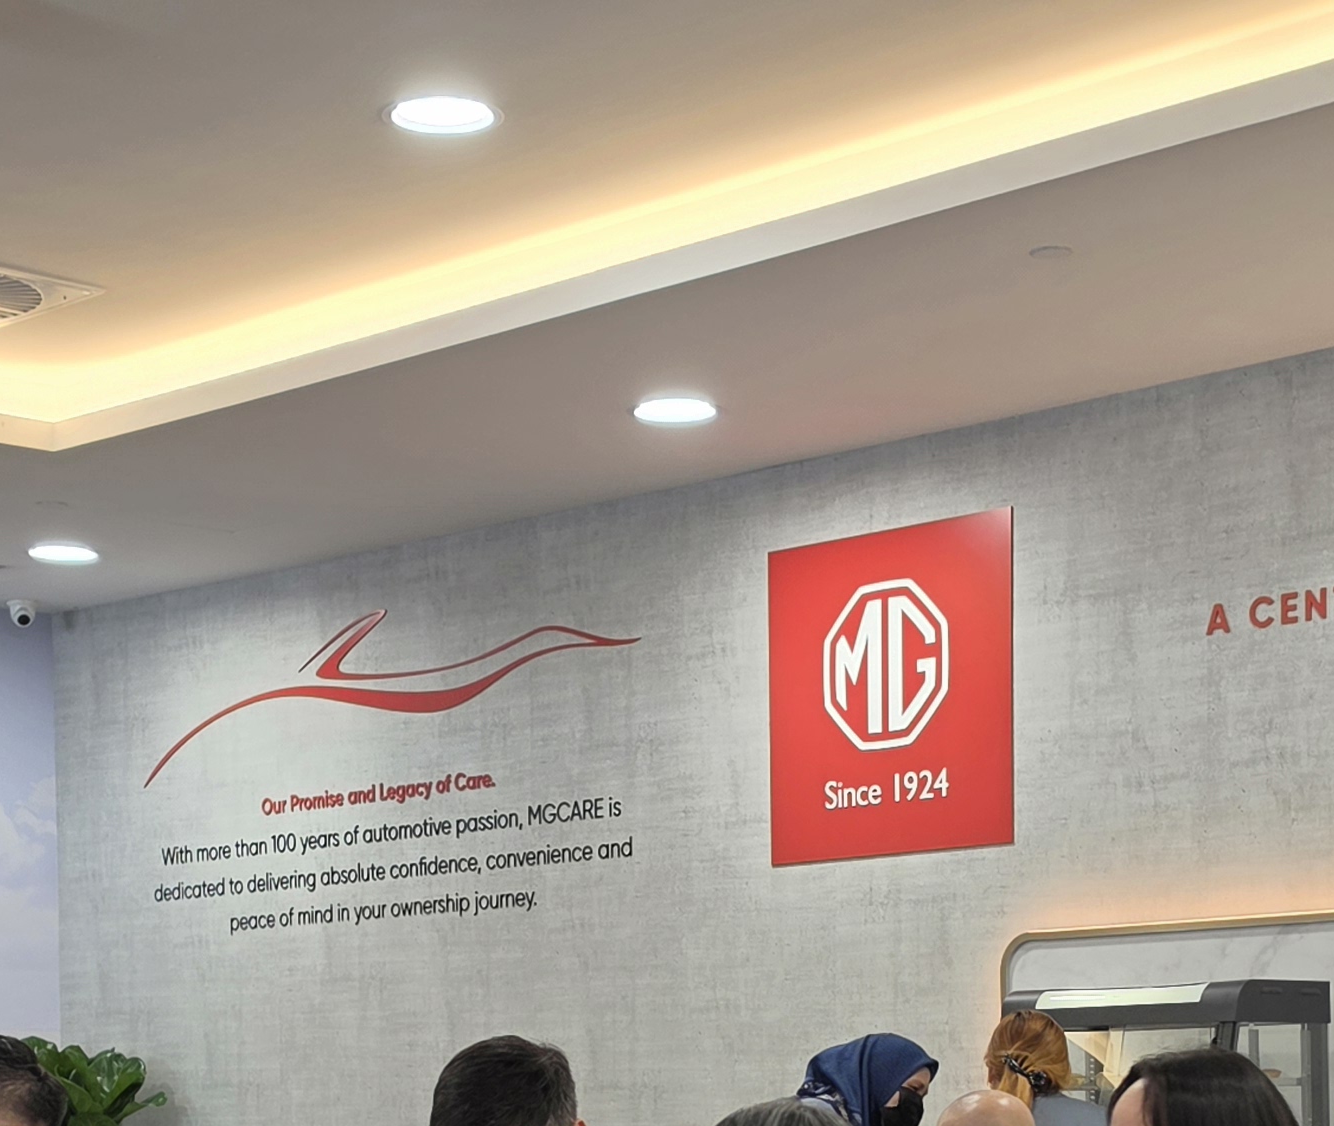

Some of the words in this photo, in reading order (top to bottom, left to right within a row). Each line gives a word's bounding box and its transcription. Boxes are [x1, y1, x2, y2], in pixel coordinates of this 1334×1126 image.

[1206, 603, 1231, 636] A
[835, 595, 936, 734] MG
[261, 798, 287, 816] Our
[291, 790, 344, 813] Promise
[348, 784, 375, 805] and
[379, 782, 432, 804] Legacy
[436, 774, 452, 794] of
[454, 773, 496, 791] Care.
[824, 780, 882, 810] Since
[894, 767, 949, 802] 1924
[161, 845, 193, 866] With
[197, 845, 231, 863] more
[235, 839, 267, 858] than
[271, 832, 296, 853] 100
[300, 832, 340, 855] years
[344, 825, 359, 847] of
[363, 816, 451, 843] automotive
[456, 809, 523, 838] passion,
[527, 798, 604, 826] MGCARE
[608, 797, 622, 818] is
[154, 878, 225, 902] dedicated
[229, 878, 243, 895] to
[247, 870, 316, 893] delivering
[320, 862, 385, 886] absolute
[390, 856, 482, 879] confidence,
[486, 844, 593, 871] convenience
[598, 836, 633, 860] and
[230, 912, 276, 936] peace
[279, 907, 295, 927] of
[298, 903, 333, 926] mind
[337, 903, 349, 922] in
[354, 902, 387, 926] your
[390, 893, 470, 918] ownership
[473, 891, 537, 916] journey.
